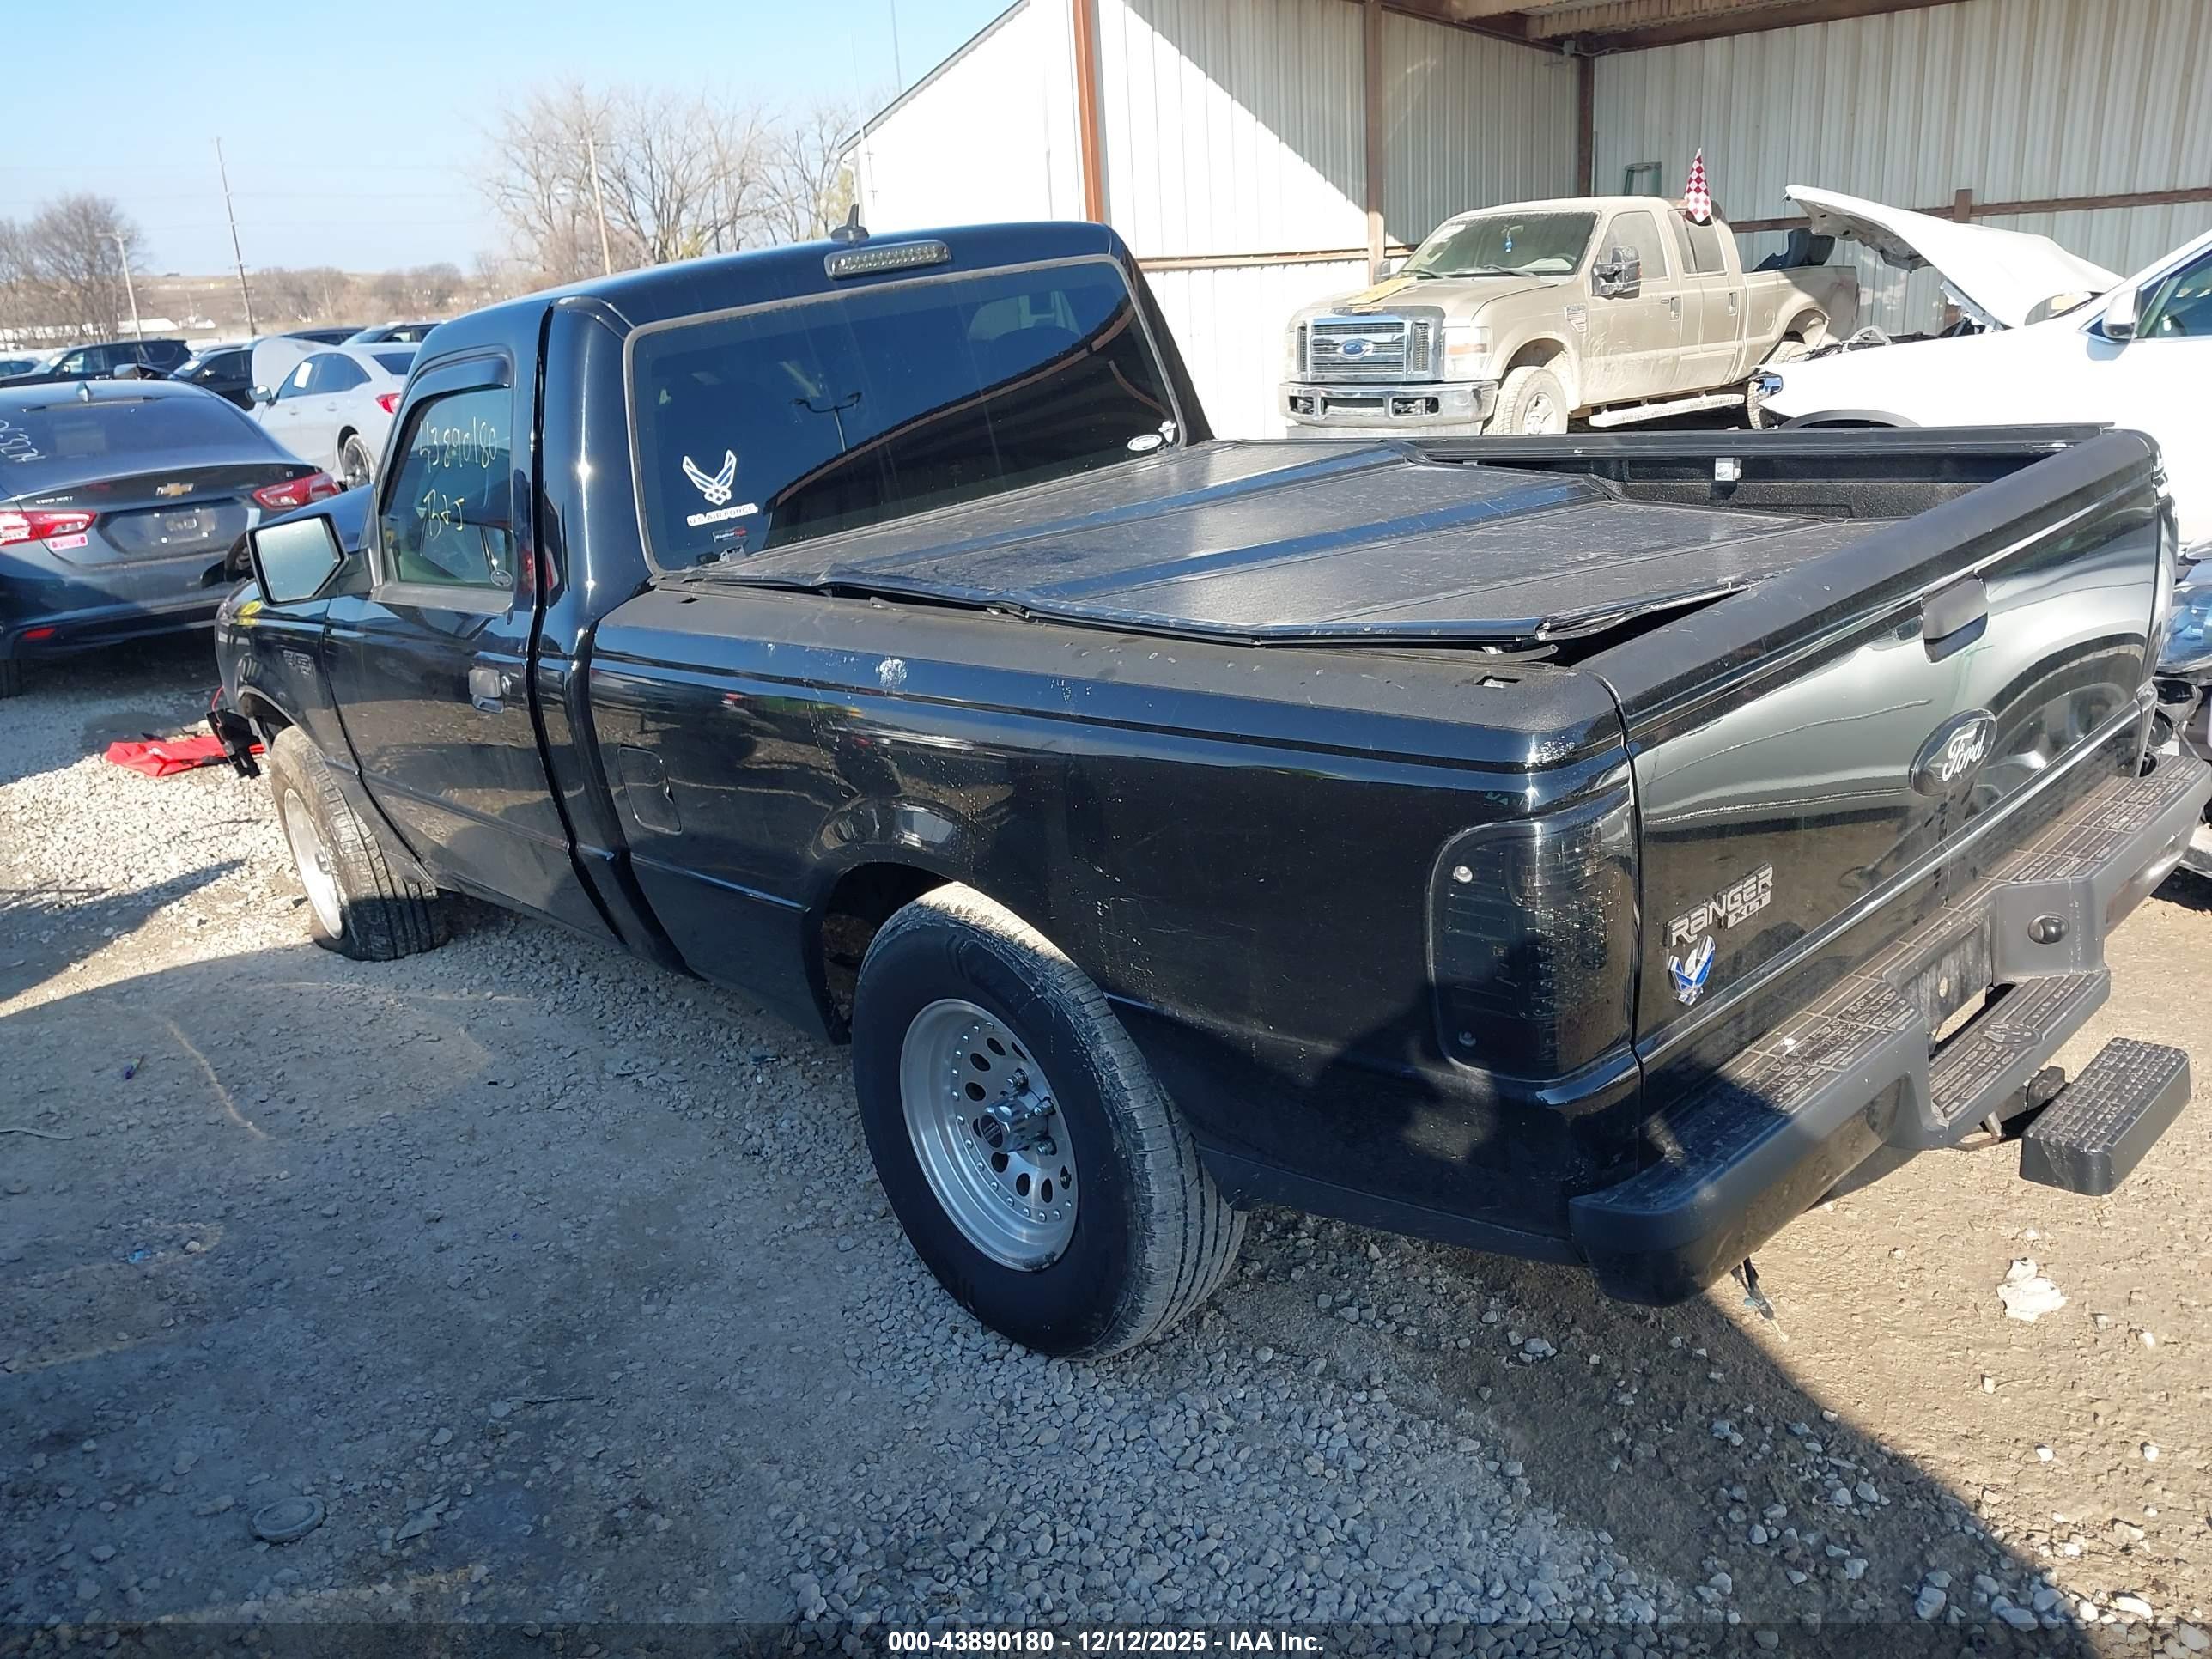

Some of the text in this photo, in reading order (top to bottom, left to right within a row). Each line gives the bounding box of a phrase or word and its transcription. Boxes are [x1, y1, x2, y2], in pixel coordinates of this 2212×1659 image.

[419, 416, 498, 474] 43890180
[708, 512, 722, 520] AIR
[724, 506, 754, 517] FORCE
[1942, 727, 1985, 782] Ford
[1670, 866, 1774, 948] RANGER
[1727, 890, 1771, 930] XLT
